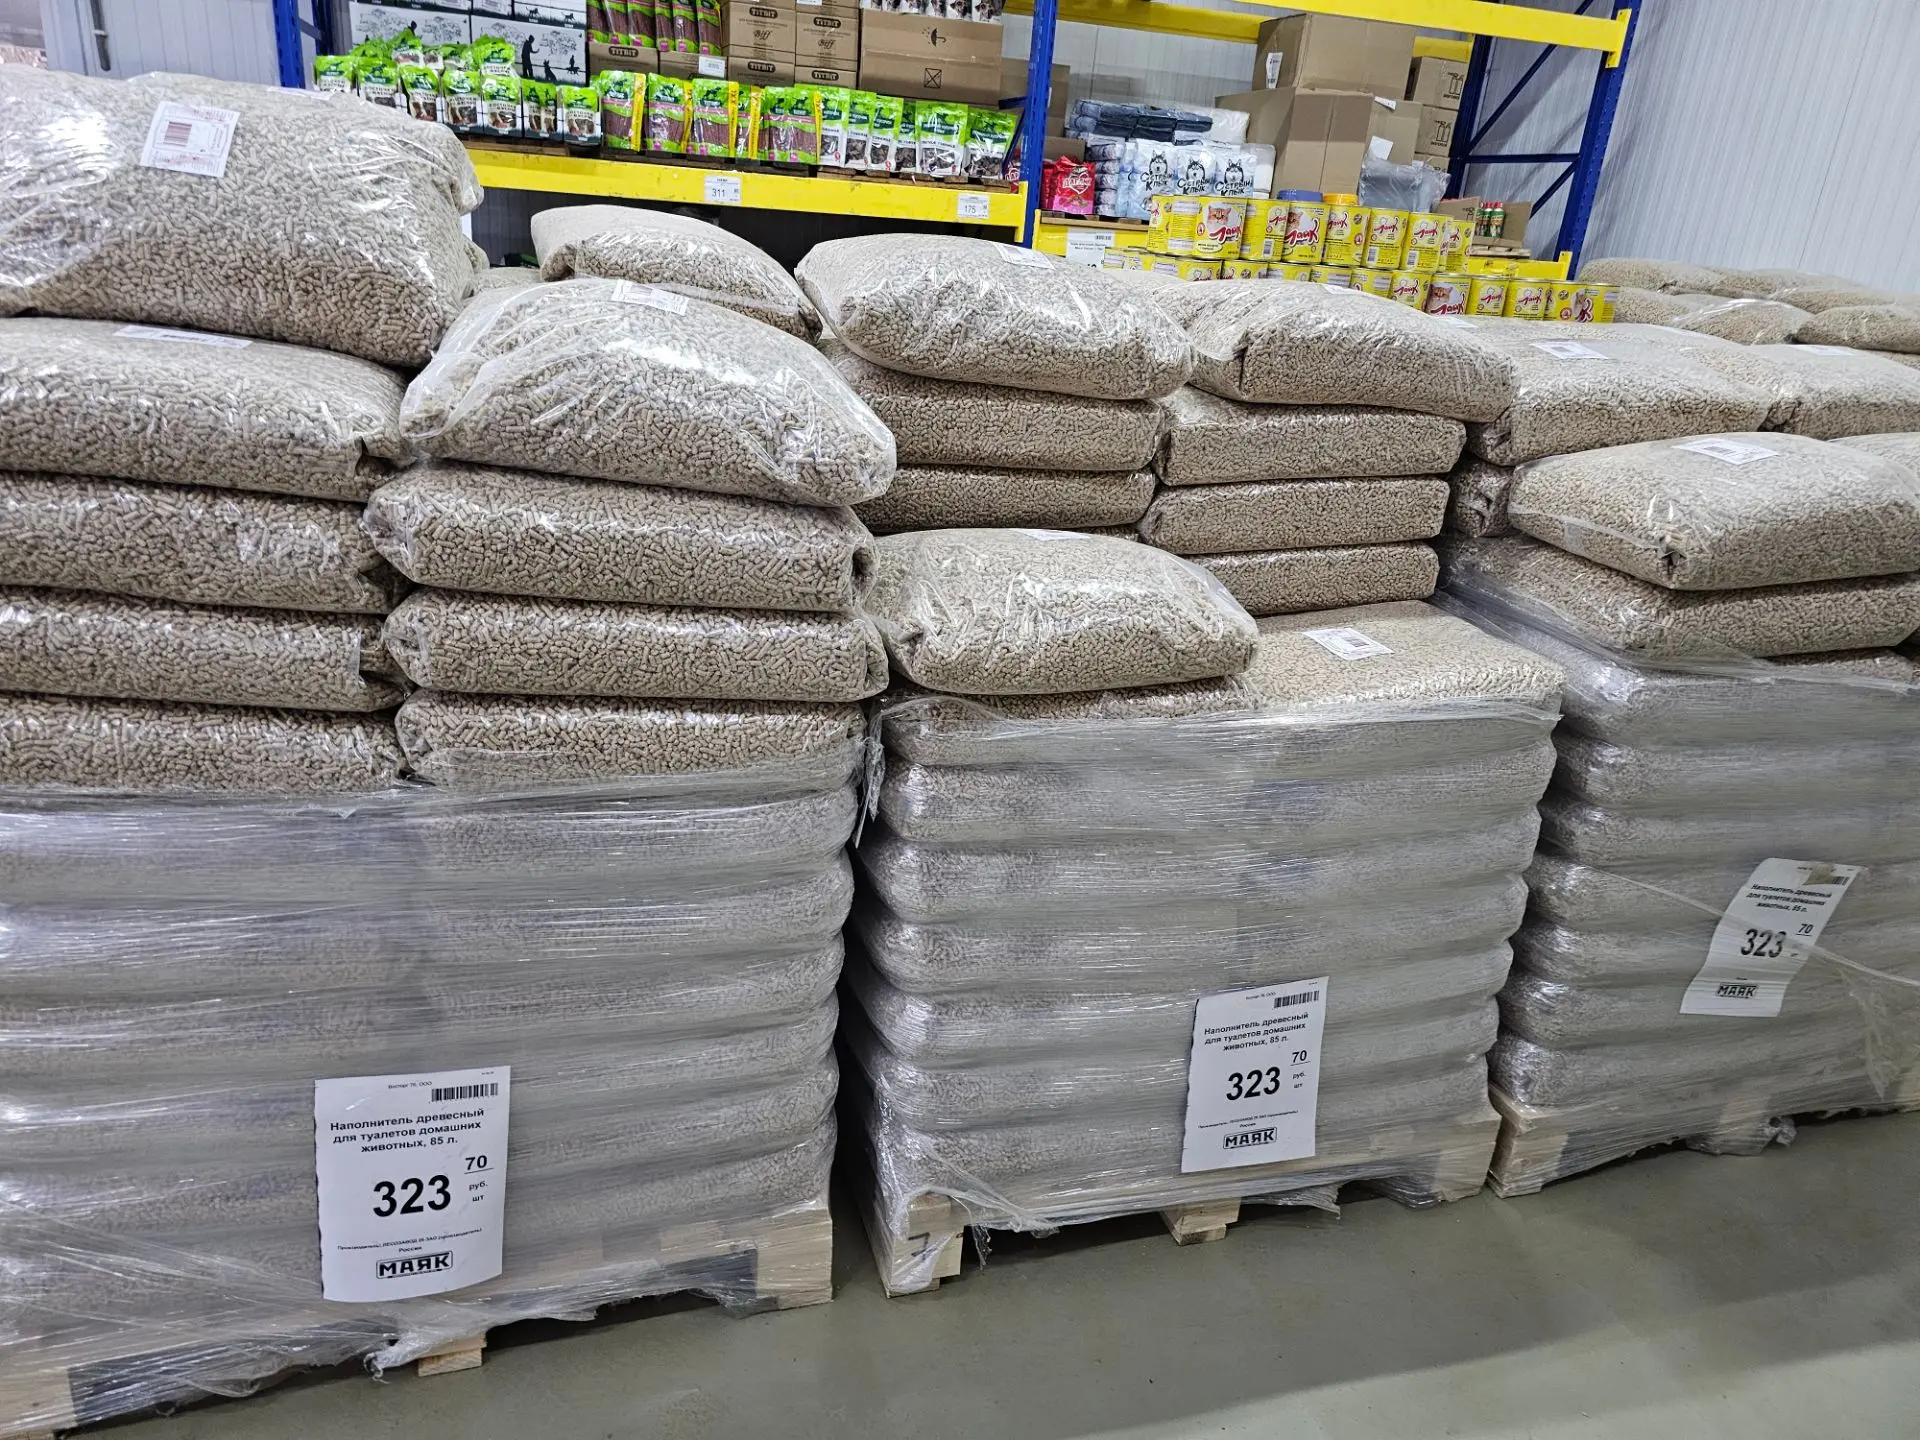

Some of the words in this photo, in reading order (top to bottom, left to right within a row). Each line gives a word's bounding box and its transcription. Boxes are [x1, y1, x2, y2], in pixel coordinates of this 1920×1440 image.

[712, 188, 726, 198] 311
[1798, 923, 1814, 934] 70
[1740, 928, 1787, 958] 323
[1204, 1021, 1260, 1035] Наполнитель
[1261, 1012, 1309, 1027] древесный
[1204, 1037, 1222, 1045] для
[1223, 1030, 1261, 1043] туалетов
[1263, 1023, 1306, 1036] домашних
[1223, 1039, 1268, 1052] животных,
[1269, 1036, 1280, 1044] 85
[1292, 1050, 1307, 1063] 70
[1226, 1066, 1281, 1101] 323
[1293, 1071, 1306, 1079] руб.
[330, 1116, 413, 1131] Наполнитель
[416, 1108, 485, 1124] древесный
[333, 1134, 357, 1144] для
[360, 1128, 416, 1142] туалетов
[418, 1122, 481, 1136] домашних
[1225, 1130, 1275, 1148] МАЯК
[361, 1140, 427, 1153] животных,
[430, 1136, 444, 1146] 85
[465, 1155, 488, 1171] 70
[468, 1180, 488, 1192] руб.
[372, 1174, 451, 1218] 323
[472, 1194, 485, 1202] шт
[379, 1255, 450, 1277] МАЯК
